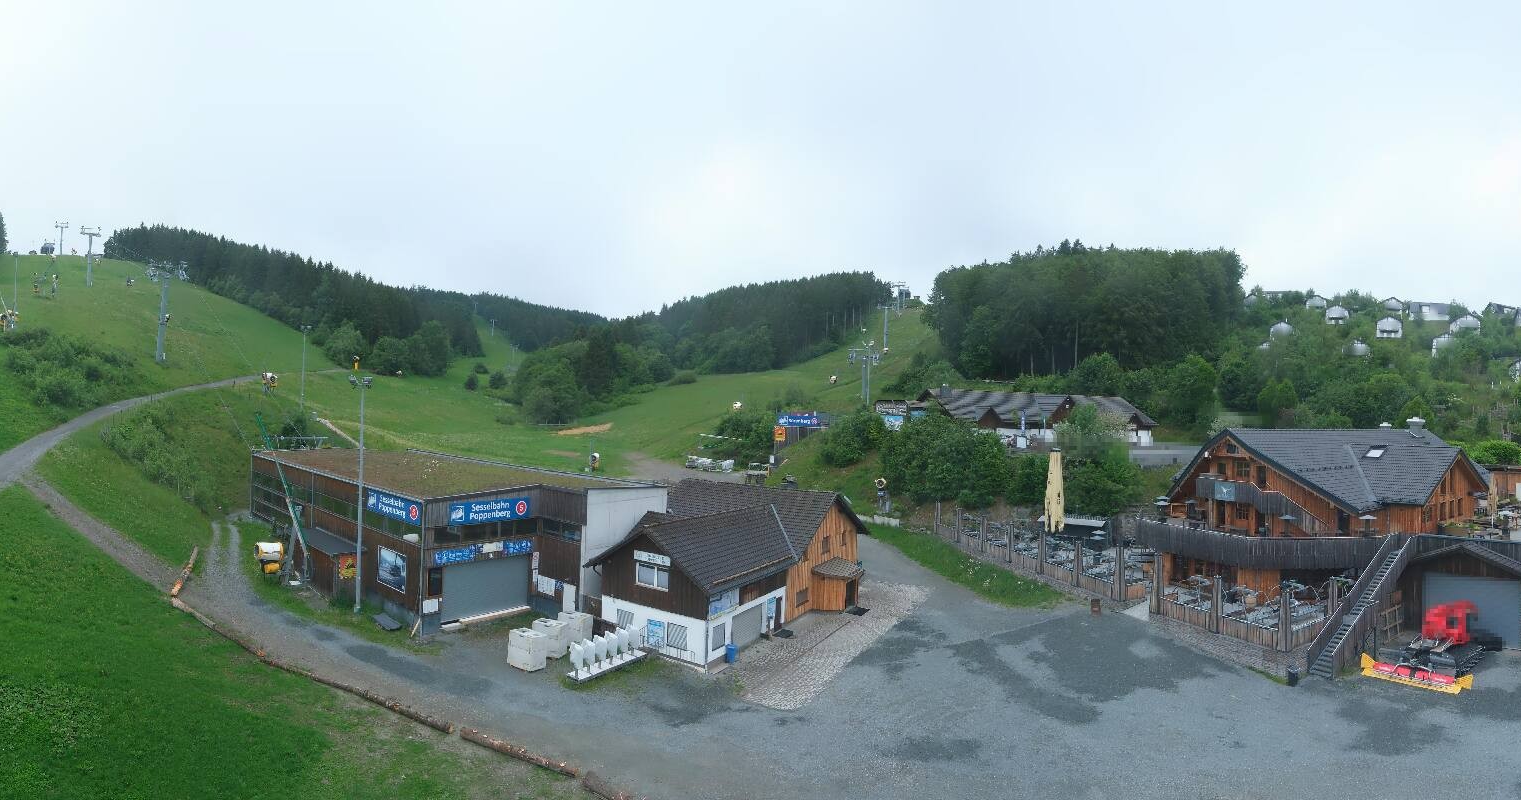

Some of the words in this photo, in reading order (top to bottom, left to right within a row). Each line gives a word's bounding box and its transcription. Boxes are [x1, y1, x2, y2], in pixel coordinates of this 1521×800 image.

[378, 502, 406, 518] Poppenberg
[471, 501, 510, 512] Sesselbahn
[519, 504, 524, 512] 5
[469, 510, 511, 521] Poppenberg
